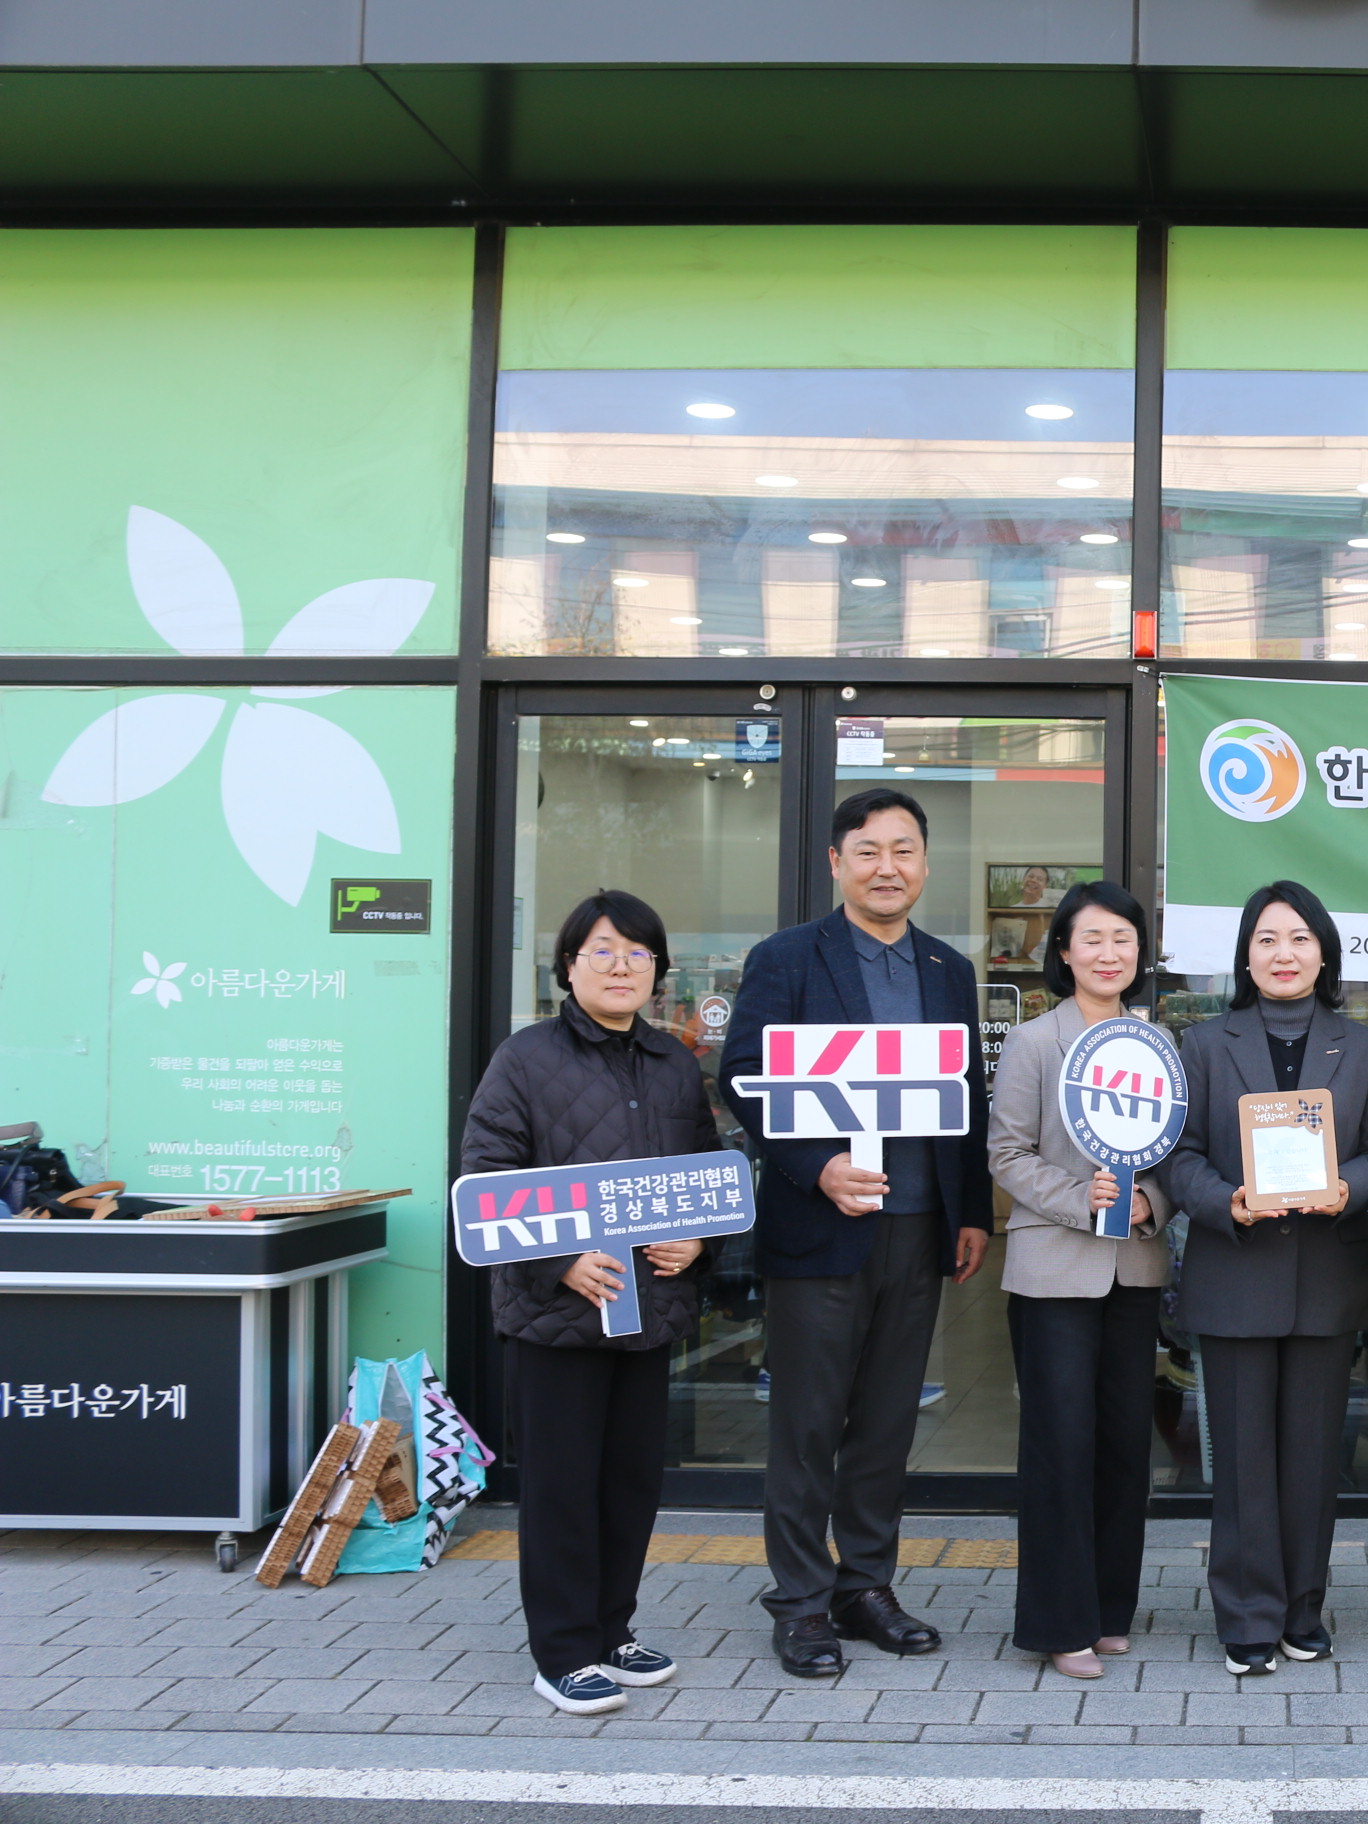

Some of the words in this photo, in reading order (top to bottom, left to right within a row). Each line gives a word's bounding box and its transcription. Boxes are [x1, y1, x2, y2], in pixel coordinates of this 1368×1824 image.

[362, 911, 385, 920] CCTV
[189, 967, 347, 1000] 아름다운가게
[979, 1021, 1011, 1034] 0:00
[266, 1037, 345, 1053] 아름다운가게는
[149, 1056, 194, 1071] 기증받은
[197, 1057, 231, 1072] 물건을
[272, 1058, 295, 1072] 얻은
[299, 1058, 344, 1073] 수익으로
[1071, 1052, 1087, 1079] KOREA
[1084, 1024, 1128, 1053] ASSOCIATION
[1128, 1024, 1139, 1034] OF
[1138, 1028, 1165, 1052] HEALTH
[1162, 1049, 1183, 1098] PROMOTION
[181, 1077, 204, 1091] 우리
[207, 1078, 242, 1091] 사회의
[245, 1078, 280, 1092] 어려운
[283, 1079, 317, 1093] 이웃을
[320, 1079, 344, 1093] 돕는
[739, 1030, 964, 1133] KH
[1081, 1064, 1164, 1123] KH
[211, 1099, 246, 1113] 나눔과
[249, 1099, 283, 1113] 순환의
[287, 1099, 343, 1114] 가게입니다
[1075, 1117, 1153, 1167] 한국건강관리협회
[1153, 1135, 1172, 1155] 경북
[148, 1164, 194, 1178] 대표번호
[199, 1164, 341, 1193] 1577-1113
[597, 1165, 740, 1201] 한국건강관리협회
[465, 1182, 592, 1252] KH
[604, 1226, 627, 1236] Korea
[628, 1220, 672, 1234] Association
[672, 1218, 681, 1228] of
[682, 1215, 706, 1227] Health
[707, 1211, 745, 1224] Promotion
